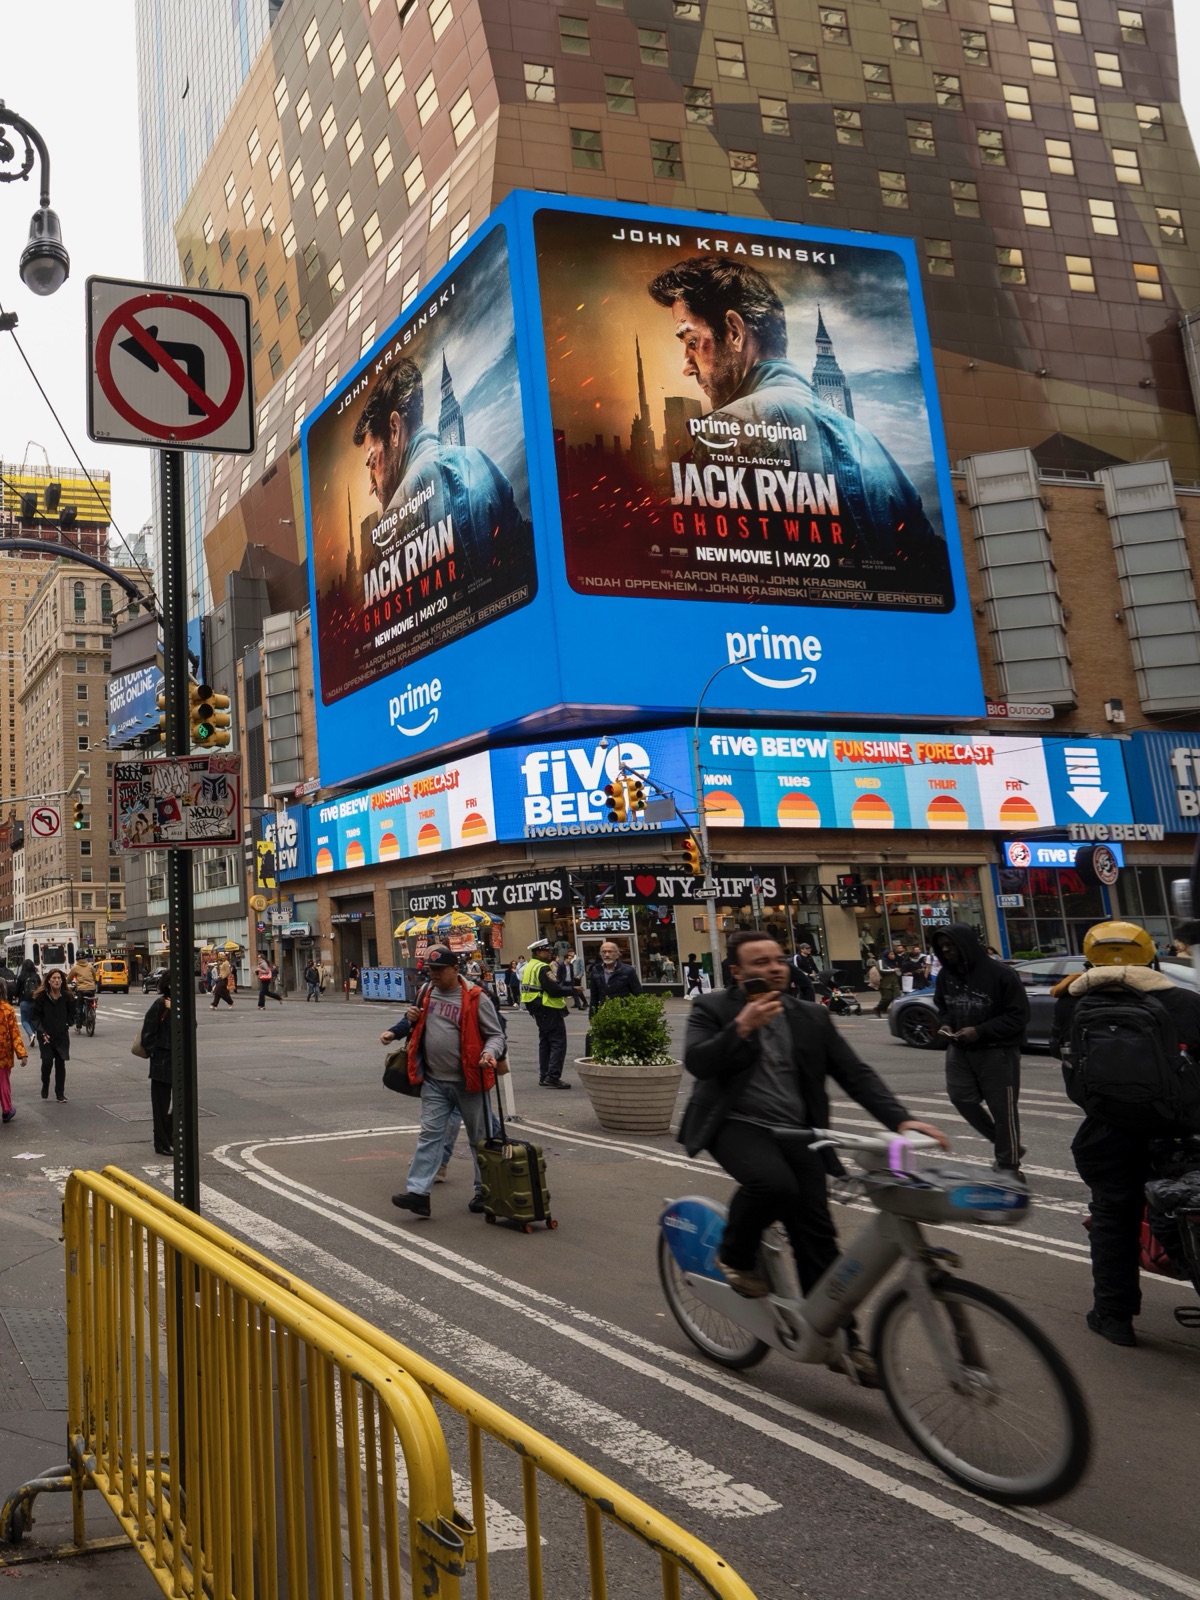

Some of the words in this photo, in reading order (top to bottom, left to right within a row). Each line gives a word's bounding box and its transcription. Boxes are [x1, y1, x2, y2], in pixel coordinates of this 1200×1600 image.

[612, 228, 681, 247] JOHN
[697, 237, 836, 265] KRASINSKI
[337, 375, 369, 415] JOHN
[375, 283, 455, 375] KRASINSKI
[689, 416, 741, 436] prime
[744, 420, 808, 442] original
[709, 453, 734, 463] TOM
[737, 455, 791, 467] CLANCY'S
[670, 461, 752, 511] JACK
[754, 468, 840, 516] RYAN
[371, 513, 398, 544] prime
[399, 480, 435, 520] original
[672, 511, 769, 540] GHOST
[784, 519, 844, 545] WAR
[381, 545, 395, 558] TOM
[395, 522, 425, 548] CLANCY'S
[363, 549, 403, 611] JACK
[404, 513, 455, 582] RYAN
[696, 546, 728, 562] NEW
[729, 548, 773, 565] MOVIE
[784, 552, 813, 567] MAY
[813, 553, 830, 568] 20
[585, 576, 621, 588] NOAH
[625, 579, 697, 592] OPPENHEIM
[705, 583, 739, 595] JOHN
[742, 585, 807, 599] KRASINSKI
[821, 589, 873, 601] ANDREW
[877, 593, 944, 605] BERNSTEIN
[674, 570, 718, 581] AARON
[721, 572, 759, 584] RABIN
[766, 574, 799, 586] JOHN
[802, 577, 867, 590] KRASINSKI
[364, 586, 413, 633] GHOST
[420, 561, 456, 599] WAR
[374, 631, 391, 648] NEW
[391, 615, 415, 638] MOVIE
[420, 605, 436, 624] MAY
[436, 596, 448, 612] 20
[328, 683, 343, 699] NOAH
[343, 669, 377, 691] OPPENHEIM
[379, 657, 396, 673] JOHN
[397, 638, 434, 662] KRASINSKI
[441, 617, 475, 640] ANDREW
[478, 586, 528, 621] BERNSTEIN
[364, 655, 386, 671] AARON
[387, 643, 407, 659] RABIN
[410, 629, 430, 646] JOHN
[430, 606, 471, 635] KRASINSKI
[725, 625, 822, 664] prime
[109, 677, 124, 698] SELL
[110, 691, 126, 714] 100%
[126, 674, 155, 703] ONLINE.
[389, 677, 442, 726] prime
[987, 703, 1007, 716] BIG
[1008, 705, 1051, 716] OUTDOOR
[709, 735, 758, 757] five
[761, 736, 828, 759] BELOW
[833, 740, 914, 764] FUNSHINE
[916, 742, 995, 766] FORECAST
[521, 742, 650, 795] five
[703, 774, 732, 786] MON
[854, 777, 881, 789] WED
[928, 779, 957, 790] THUR
[295, 783, 304, 797] BIG
[319, 805, 339, 824] five
[339, 795, 369, 819] BELOW
[370, 783, 412, 812] FUNSHINE
[412, 769, 460, 799] FORECAST
[317, 835, 329, 846] MON
[380, 818, 394, 830] WED
[418, 809, 436, 820] THUR
[523, 820, 663, 838] fivebelow.com
[1068, 823, 1109, 841] five
[1111, 823, 1164, 841] BELOW
[1037, 848, 1067, 863] five
[409, 894, 446, 912] GIFTS
[470, 886, 498, 907] NY
[502, 879, 563, 904] GIFTS
[656, 876, 695, 898] NY
[579, 920, 631, 931] GIFTS
[602, 907, 629, 919] NY
[921, 917, 951, 926] GIFTS
[932, 907, 948, 917] NY
